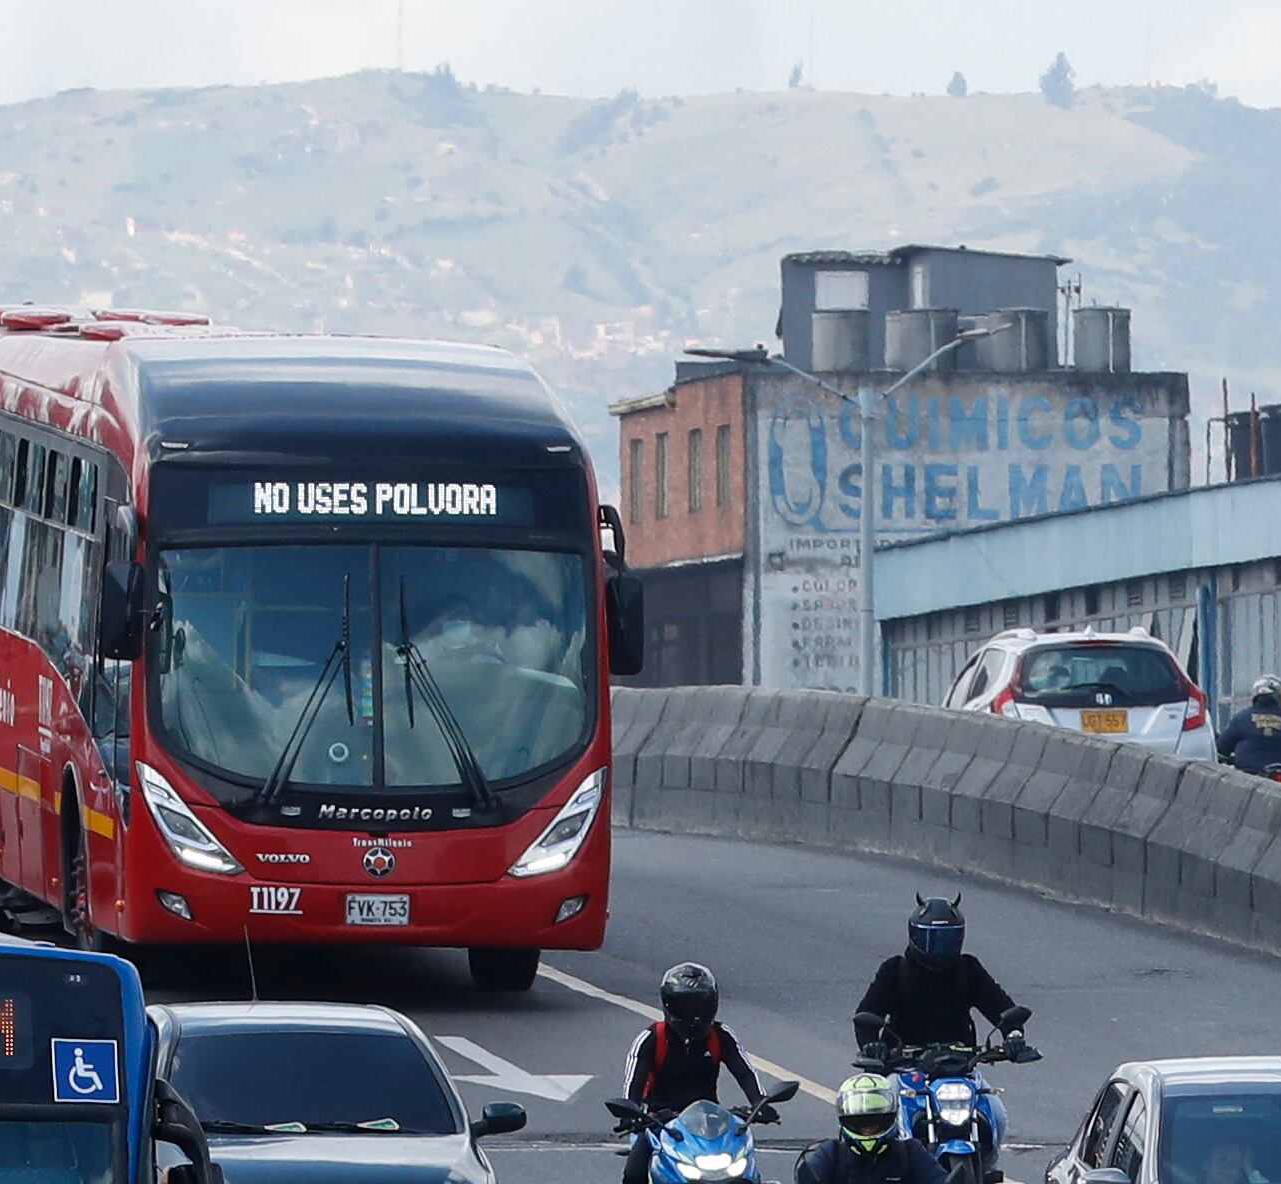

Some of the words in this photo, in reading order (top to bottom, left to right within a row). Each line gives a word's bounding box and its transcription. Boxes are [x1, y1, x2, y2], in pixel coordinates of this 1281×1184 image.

[254, 482, 291, 514] NO
[298, 482, 368, 515] USES
[376, 483, 497, 515] POLVORA
[838, 463, 1143, 521] SHELMAN
[319, 804, 433, 821] Marcopolo
[352, 837, 413, 848] TransMilenio
[256, 853, 310, 864] VOLVO
[249, 887, 302, 911] T1197
